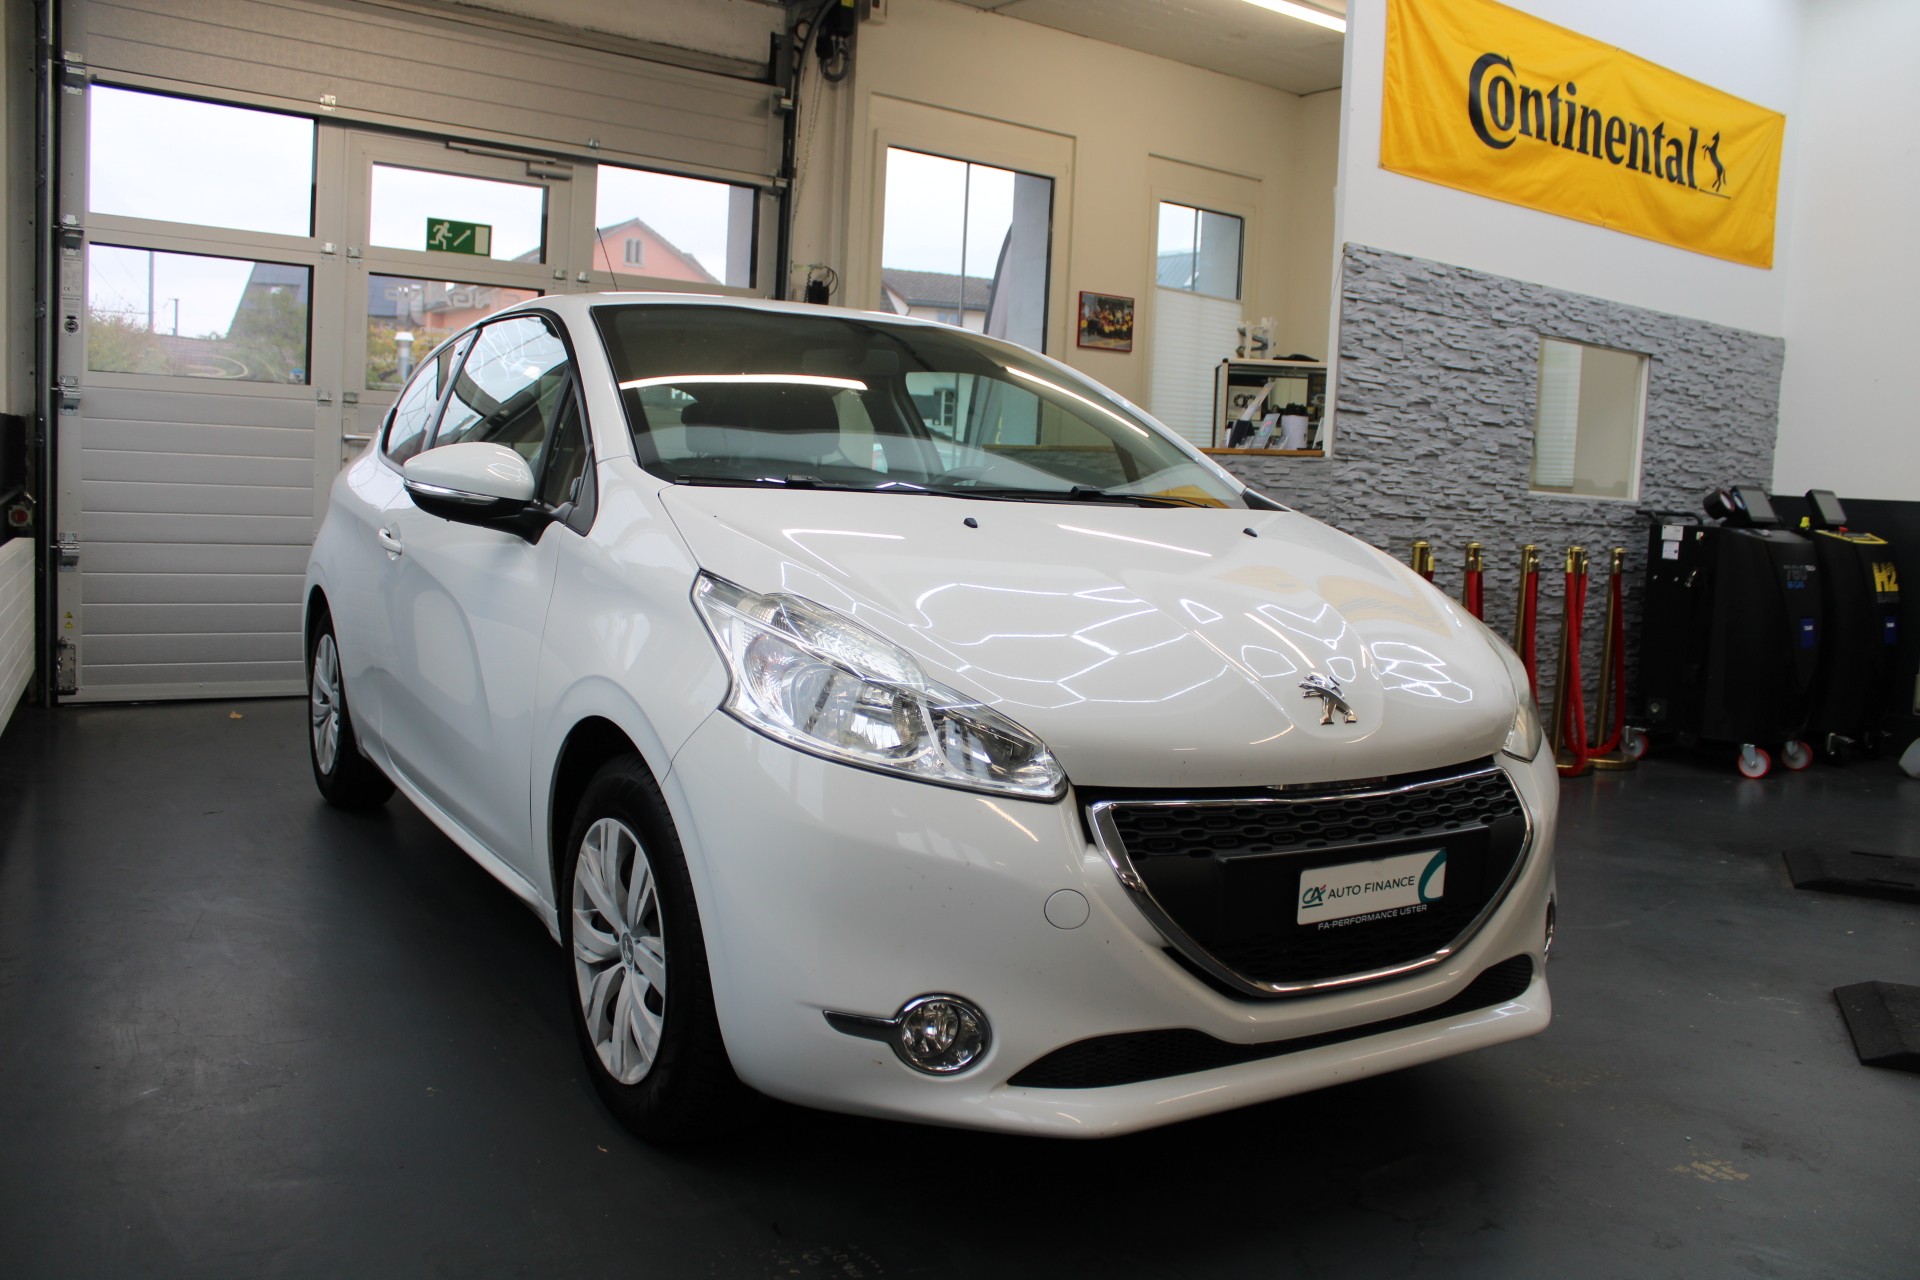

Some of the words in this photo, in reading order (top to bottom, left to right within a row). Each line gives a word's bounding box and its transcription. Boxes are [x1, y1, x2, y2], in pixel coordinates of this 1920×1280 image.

[1468, 52, 1698, 189] Continental
[1327, 884, 1361, 900] AUTO
[1364, 875, 1415, 893] FINANCE
[1318, 910, 1397, 931] FA-PERFORMANCE
[1400, 904, 1427, 916] USTER
